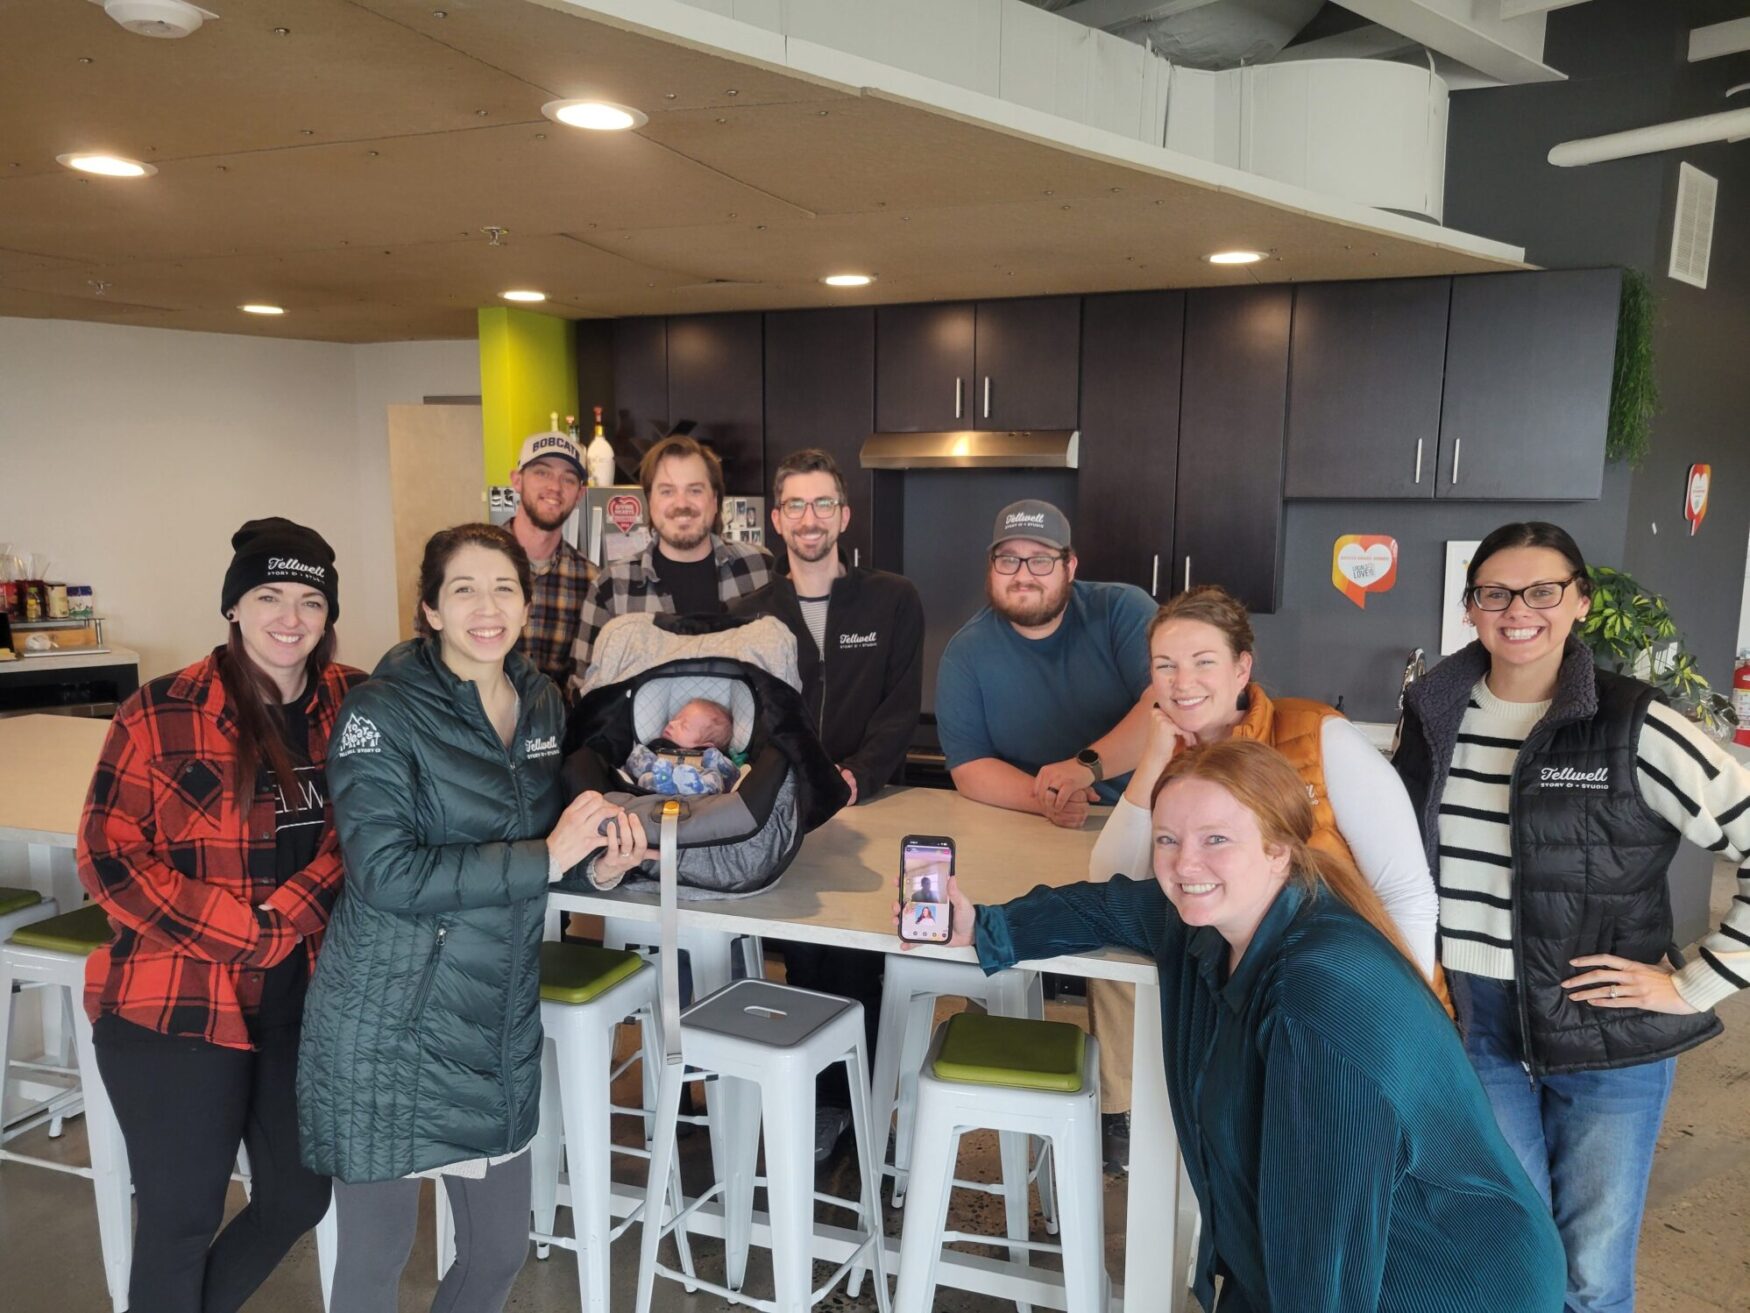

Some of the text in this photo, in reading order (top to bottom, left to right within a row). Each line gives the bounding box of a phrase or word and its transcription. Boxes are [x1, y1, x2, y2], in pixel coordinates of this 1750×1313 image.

[1005, 512, 1044, 524] Tellwell
[268, 557, 325, 577] Tellwell
[840, 632, 877, 644] Tellwell
[525, 736, 557, 752] Tellwell
[1541, 767, 1609, 782] Tellwell
